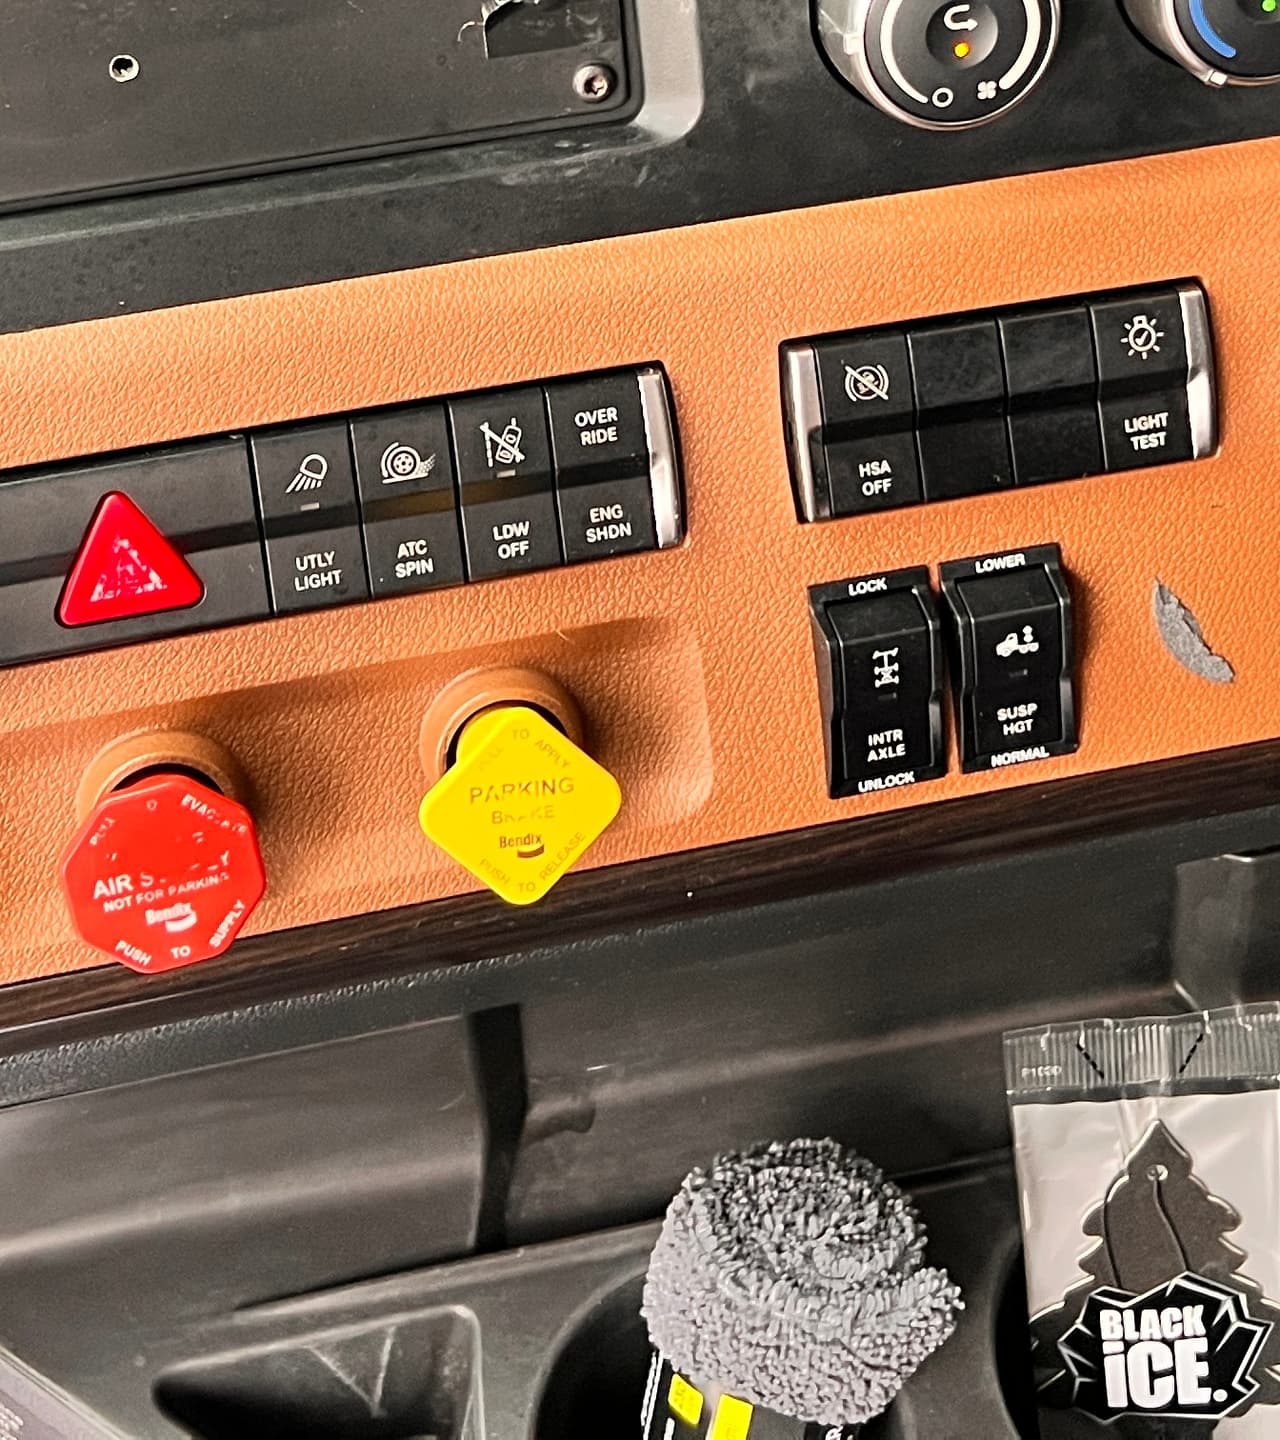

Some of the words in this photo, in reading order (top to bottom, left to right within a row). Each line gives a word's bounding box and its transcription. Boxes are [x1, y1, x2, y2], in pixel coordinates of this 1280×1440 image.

[575, 406, 618, 428] OVER
[1124, 412, 1169, 434] LIGHT
[580, 425, 619, 447] RIDE
[1130, 432, 1167, 452] TEST
[858, 460, 891, 478] HSA
[862, 479, 892, 496] OFF
[589, 503, 623, 524] ENG
[492, 521, 530, 543] LDW
[585, 521, 632, 544] SHDN
[396, 539, 428, 560] ATC
[497, 540, 530, 559] OFF
[295, 551, 336, 573] UTLY
[394, 558, 434, 579] SPIN
[975, 553, 1026, 573] LOWER
[294, 569, 342, 592] LIGHT
[848, 577, 888, 596] LOCK
[997, 703, 1038, 722] SUSP
[512, 728, 530, 740] TO
[1003, 718, 1035, 736] HGT
[868, 729, 904, 747] INTR
[867, 744, 906, 762] AXLE
[991, 746, 1049, 767] NORMAL
[470, 777, 574, 804] PARKING
[858, 771, 915, 792] UNLOCK
[499, 833, 542, 849] Bendix
[480, 858, 512, 885] PUSH
[519, 881, 536, 893] TO
[539, 831, 587, 880] RELEASE
[93, 873, 133, 899] AIR
[103, 895, 132, 913] NOT
[136, 885, 164, 904] FOR
[168, 871, 230, 896] PARKING
[145, 902, 192, 926] Bendix
[115, 940, 153, 966] PUSH
[171, 945, 191, 959] TO
[209, 899, 246, 948] SUPPLY
[1099, 1305, 1206, 1341] BLACK
